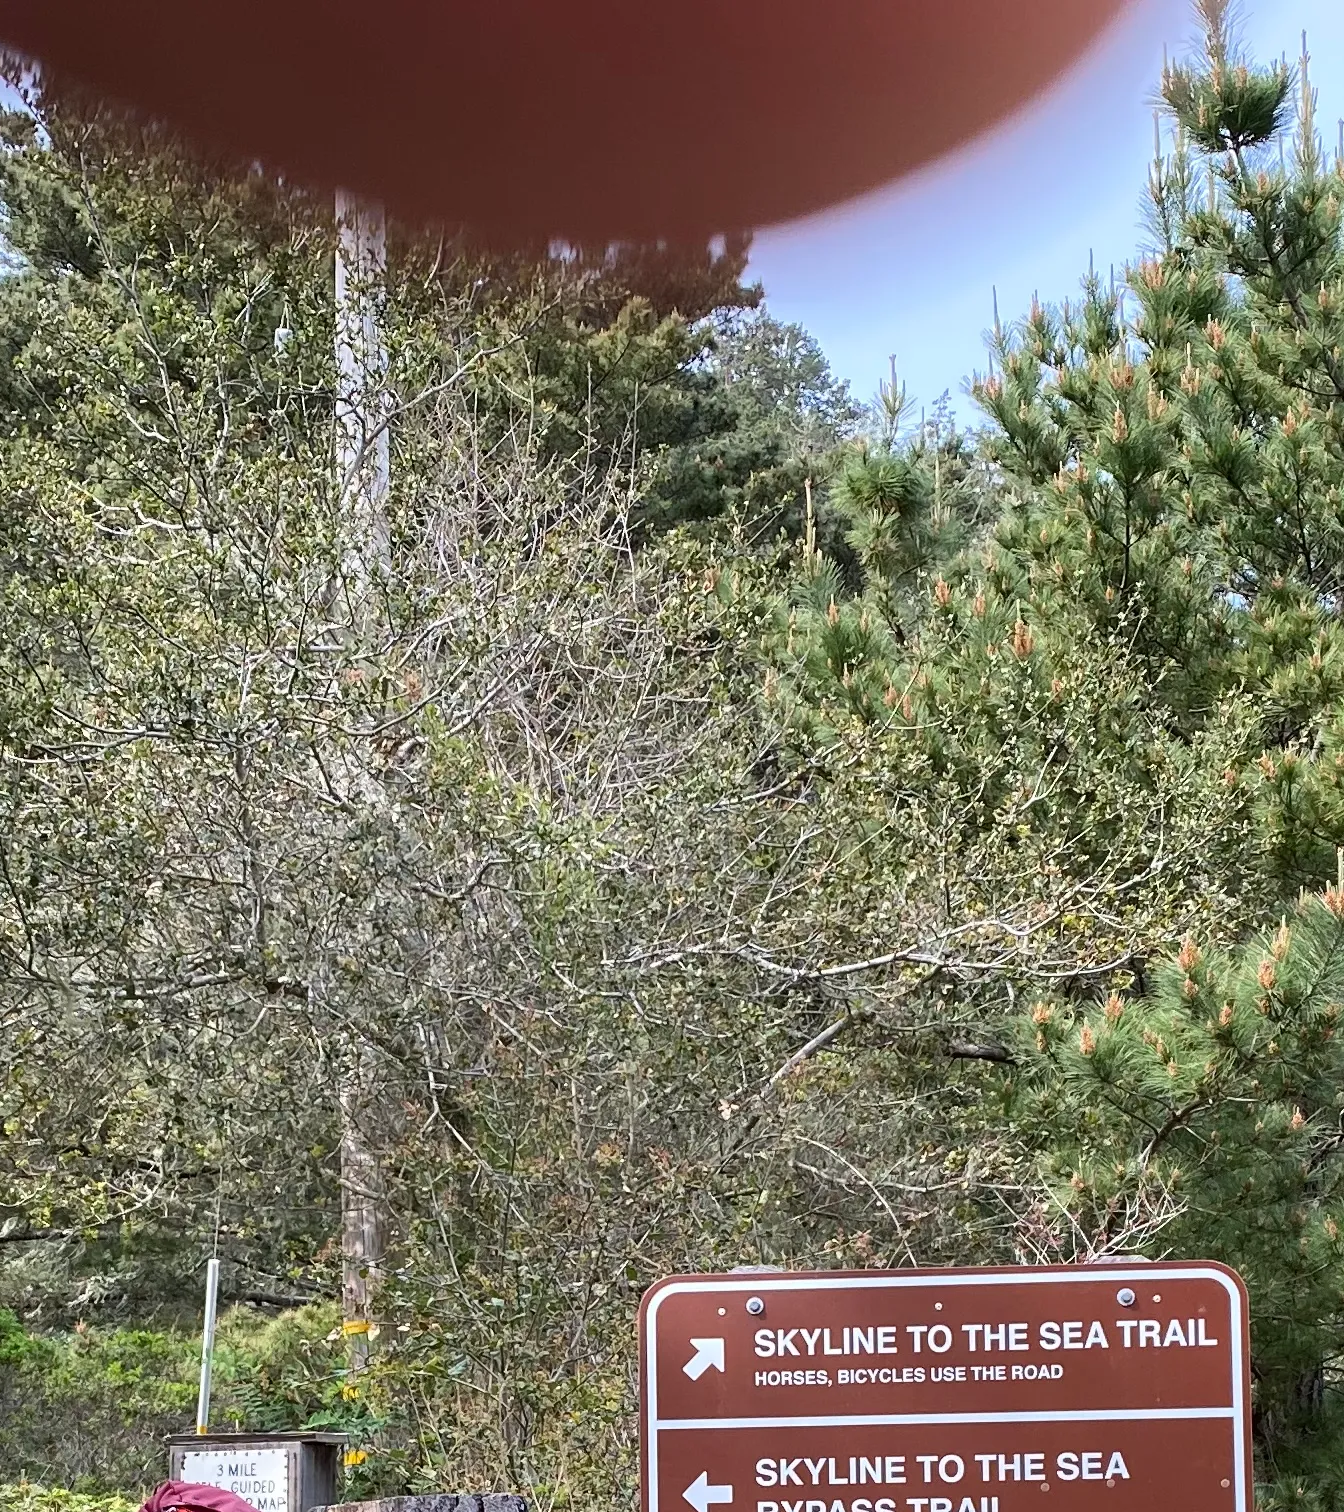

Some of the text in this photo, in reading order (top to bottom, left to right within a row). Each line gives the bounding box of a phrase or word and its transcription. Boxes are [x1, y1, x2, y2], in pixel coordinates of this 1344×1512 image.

[754, 1318, 1219, 1358] SKYLINE TO THE SEA TRAIL
[754, 1364, 1064, 1388] HORSES, BICYCLES USE THE ROAD
[216, 1463, 257, 1477] 3 MILE
[755, 1451, 1131, 1487] SKYLINE TO THE SEA
[230, 1480, 276, 1494] GUIDED
[257, 1496, 286, 1511] MAP
